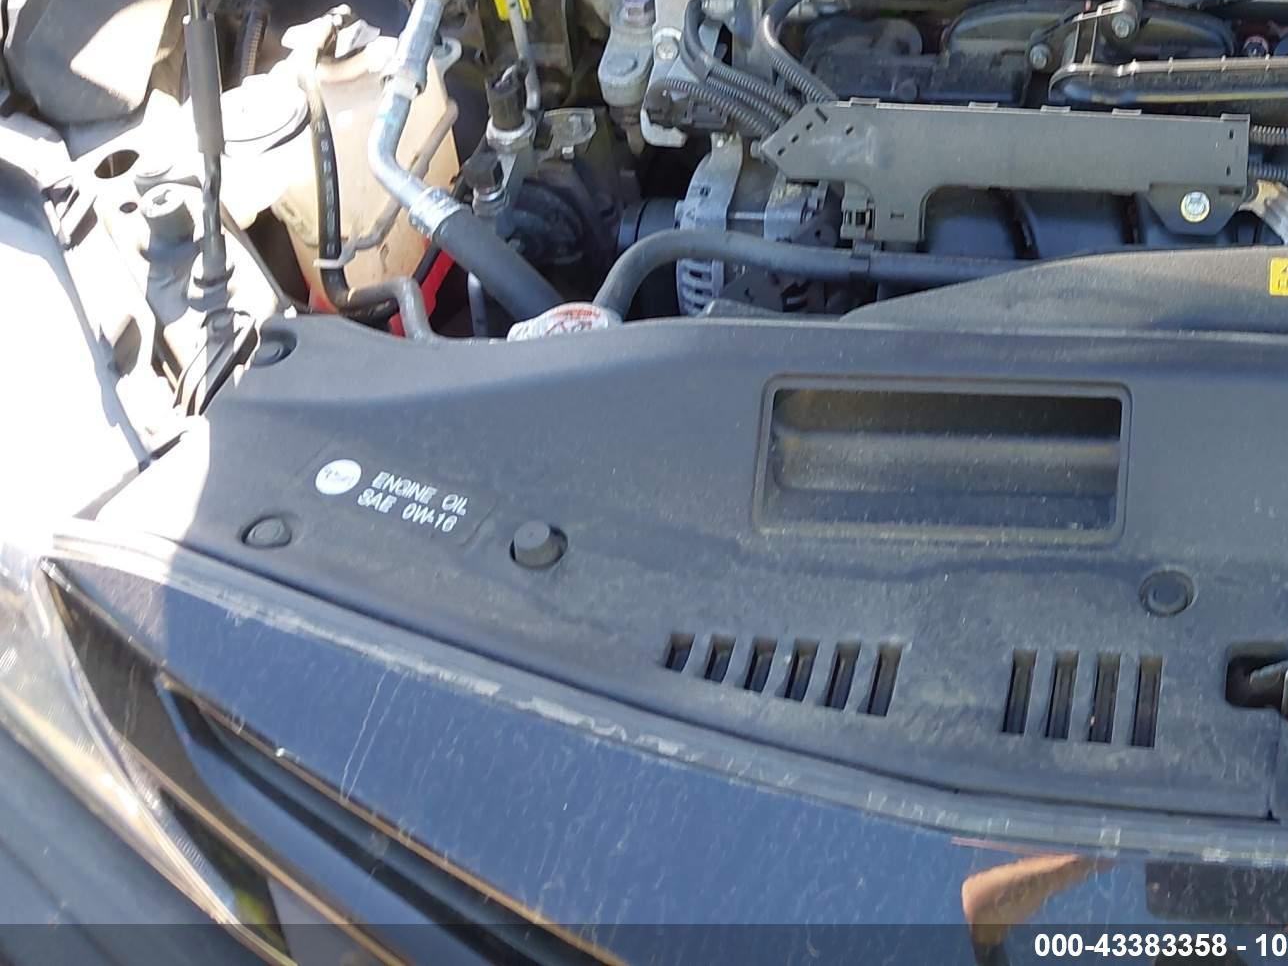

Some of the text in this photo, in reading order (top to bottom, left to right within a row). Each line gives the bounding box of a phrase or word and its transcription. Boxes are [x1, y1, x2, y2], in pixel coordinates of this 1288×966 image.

[357, 488, 397, 513] SAE
[372, 471, 438, 504] ENGINE
[442, 495, 468, 516] OIL
